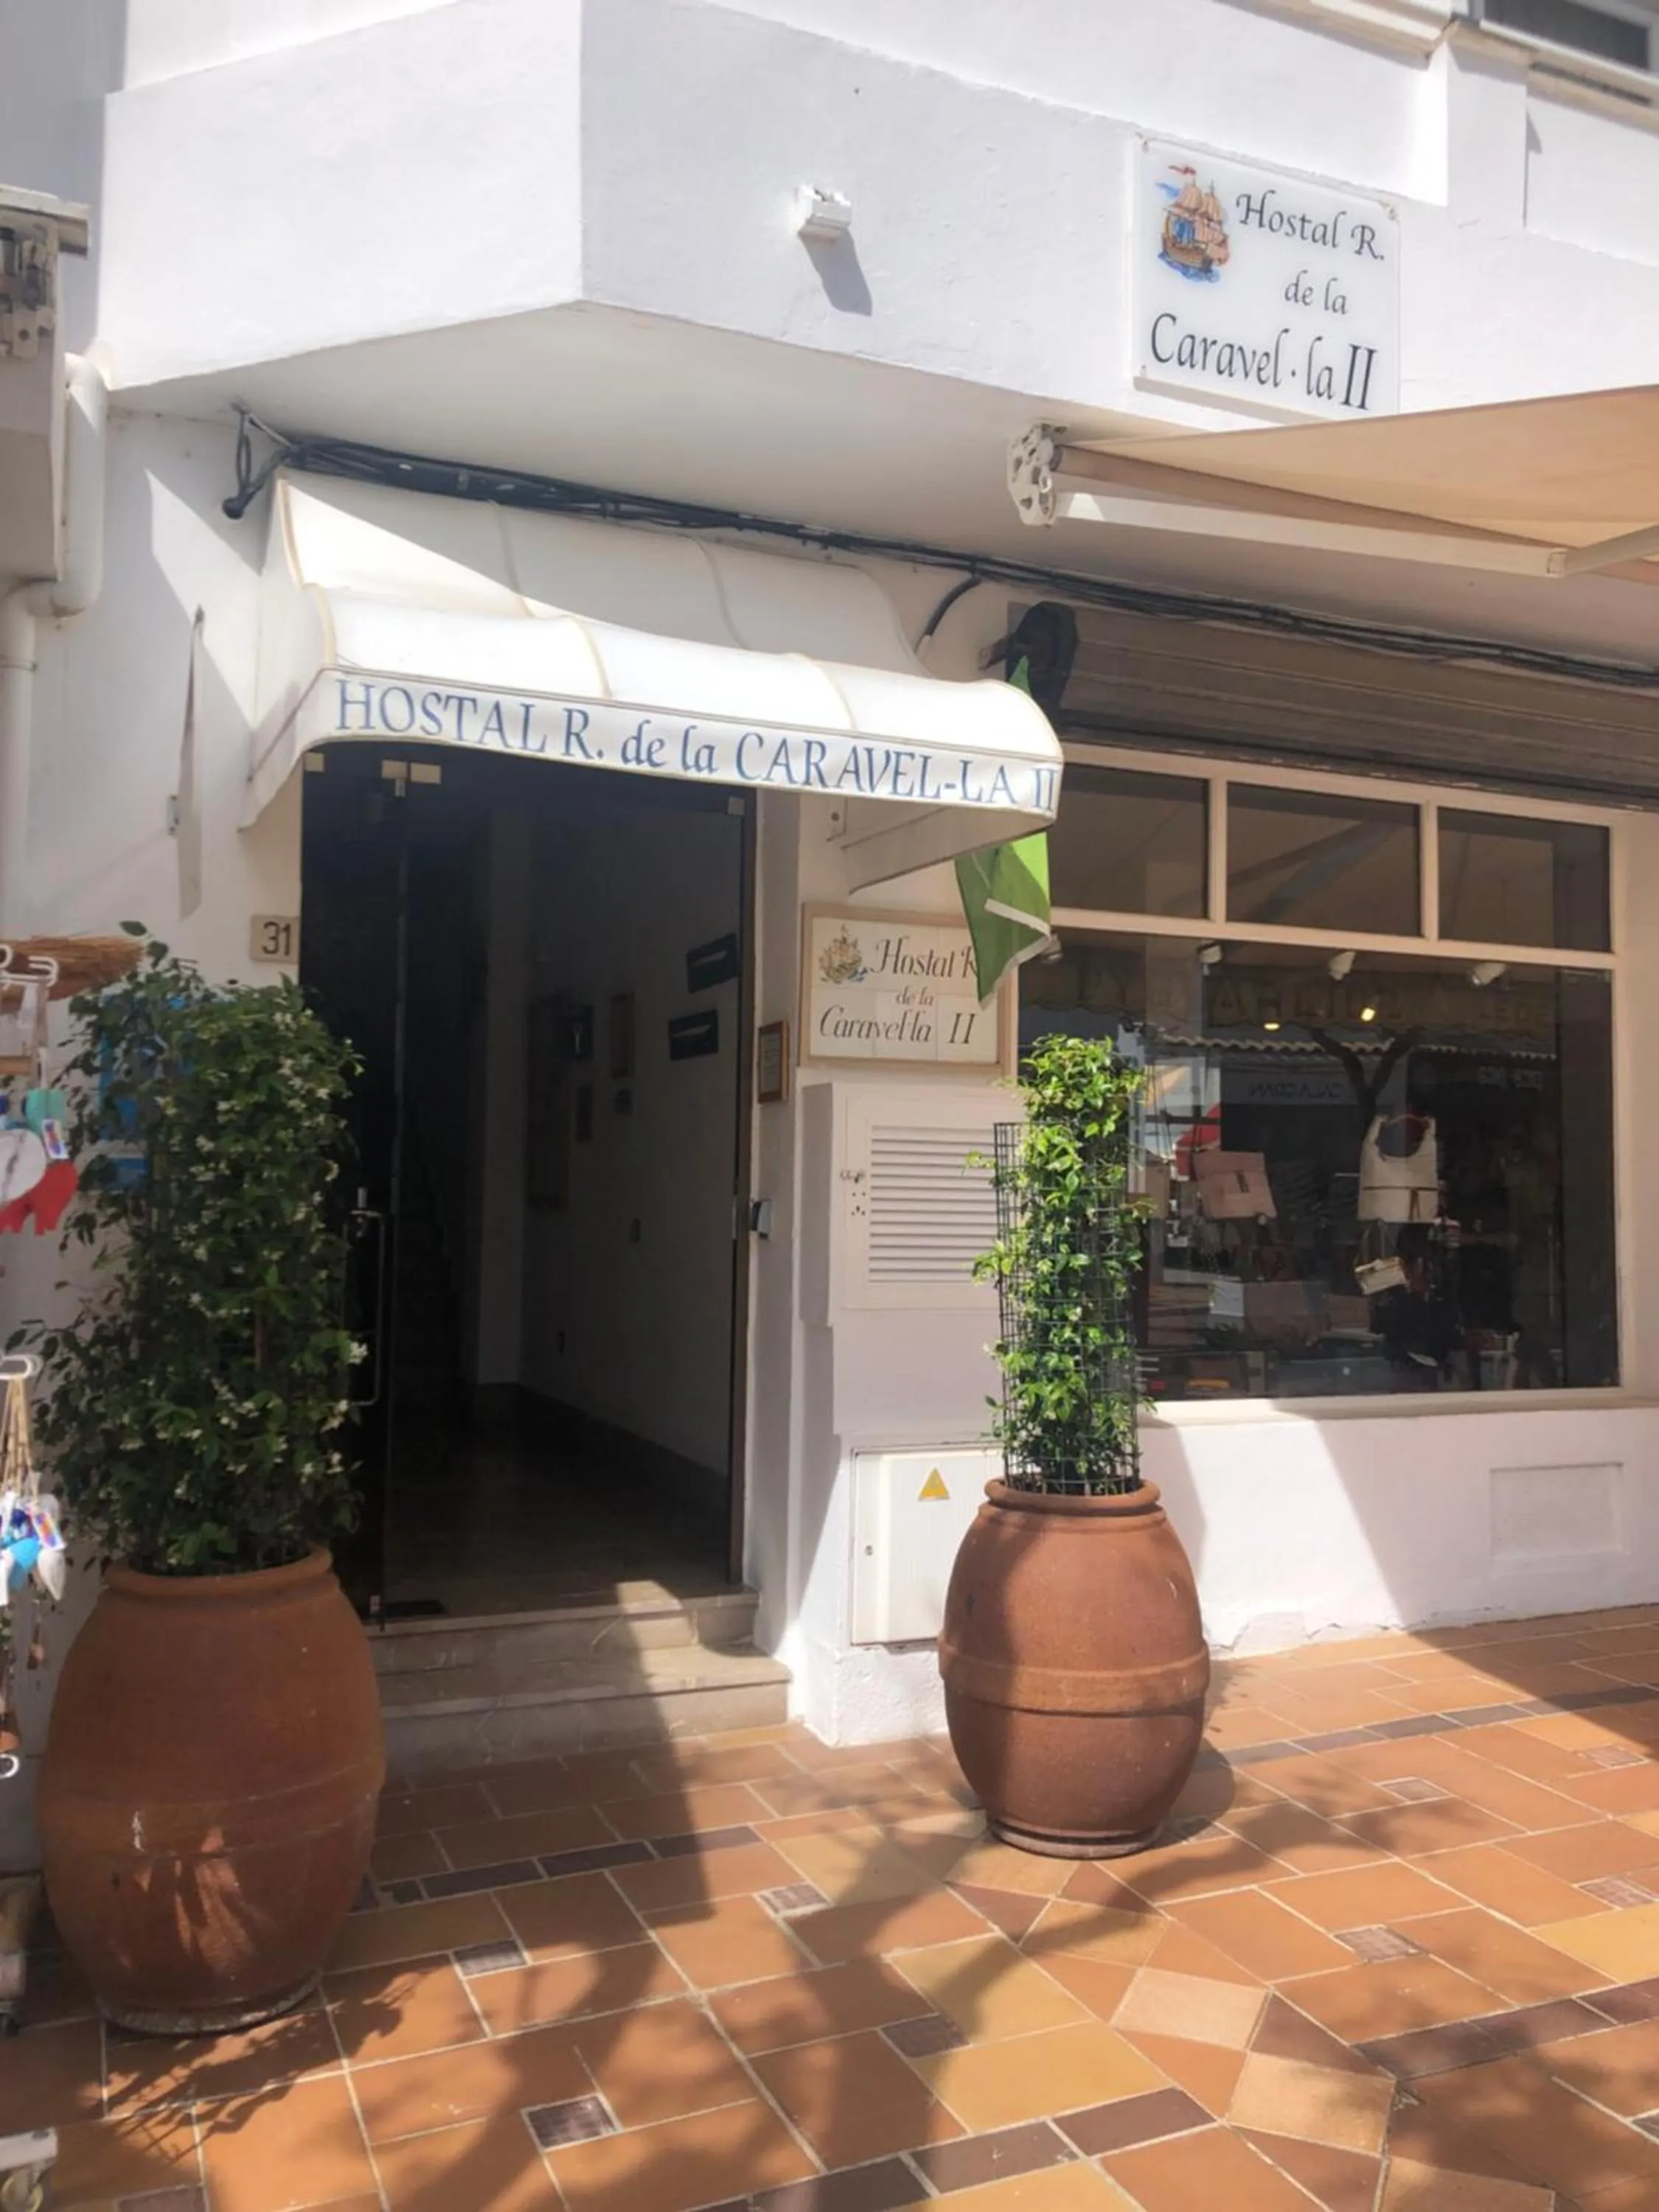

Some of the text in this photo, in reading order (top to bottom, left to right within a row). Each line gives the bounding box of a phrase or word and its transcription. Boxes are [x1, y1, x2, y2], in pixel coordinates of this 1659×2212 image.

[1236, 189, 1385, 261] Hostal R.
[1284, 269, 1349, 315] de la
[1340, 343, 1378, 410] II
[335, 678, 1059, 812] HOSTAL R. de la CARAVEL-LA II
[260, 921, 291, 956] 31
[869, 935, 956, 979] Hostal
[895, 985, 934, 1006] de la
[947, 1012, 977, 1044] II
